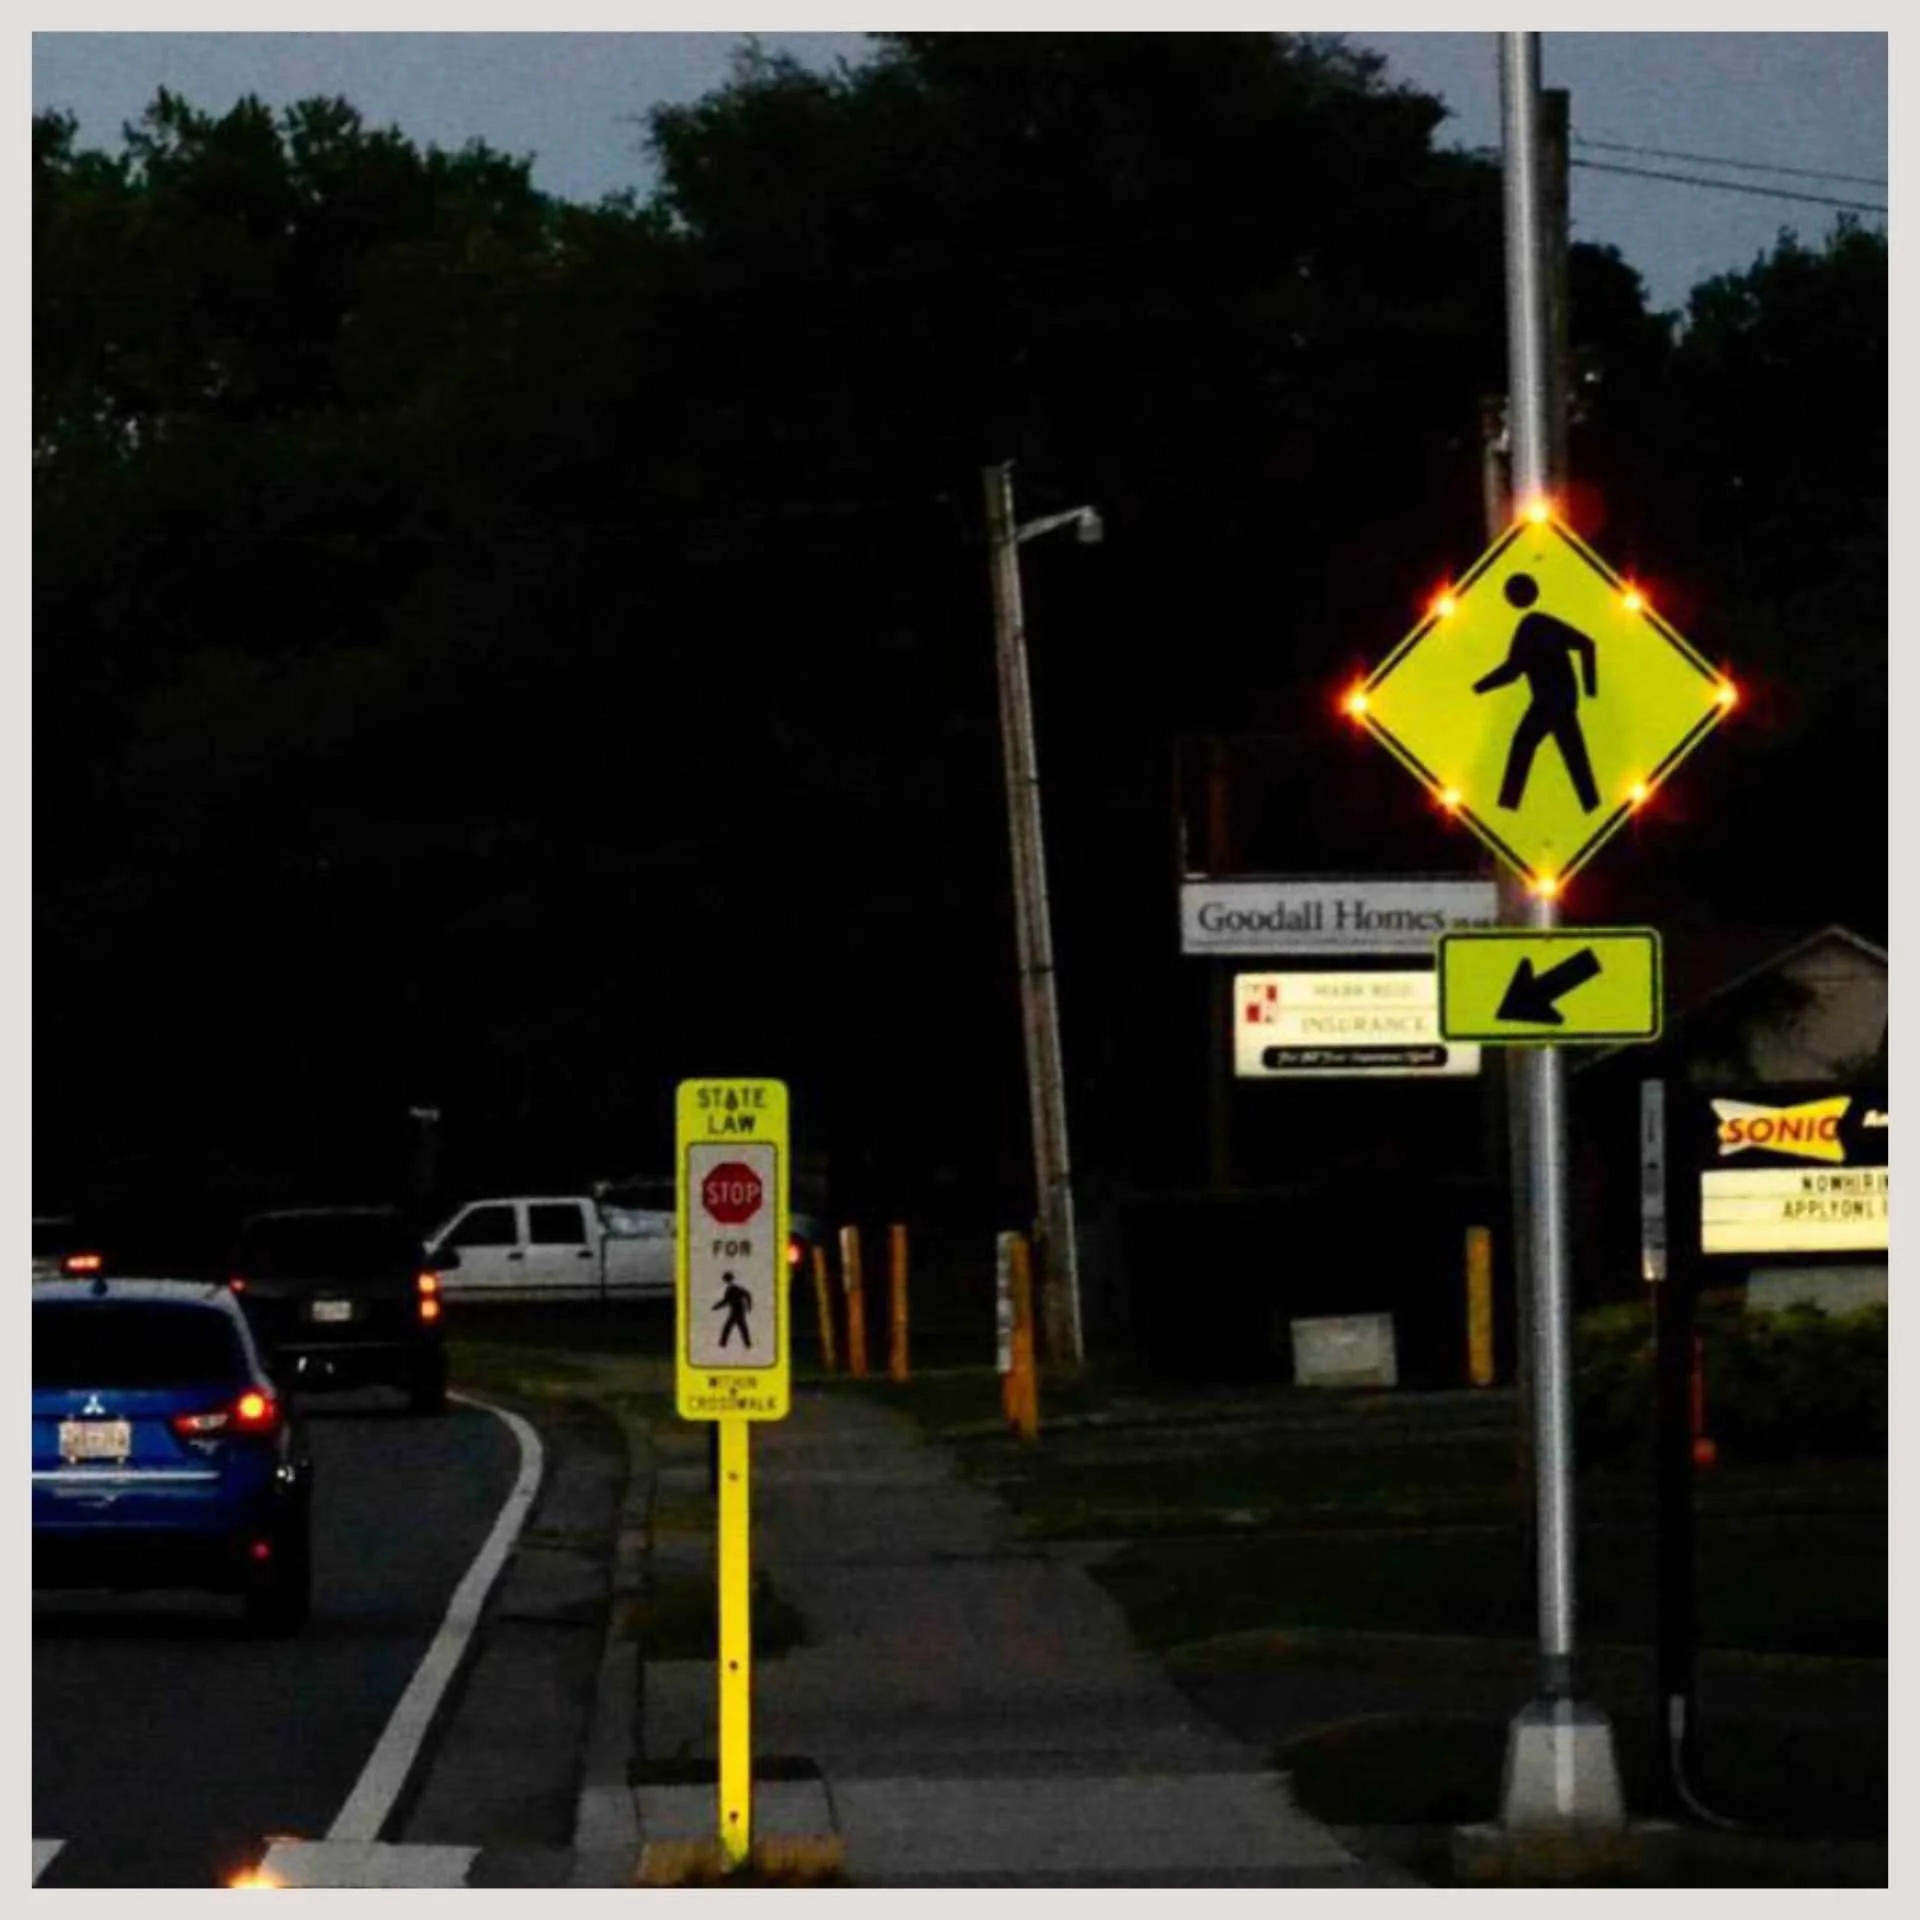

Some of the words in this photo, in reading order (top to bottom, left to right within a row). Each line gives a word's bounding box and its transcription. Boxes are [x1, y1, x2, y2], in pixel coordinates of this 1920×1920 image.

[1198, 900, 1323, 932] Goodall
[1333, 900, 1447, 932] Homes
[1301, 1016, 1428, 1033] INSURANCE
[697, 1087, 766, 1110] STATE
[706, 1115, 757, 1134] LAW
[1725, 1116, 1841, 1143] SONIC
[706, 1181, 761, 1206] STOP
[712, 1239, 752, 1258] FOR
